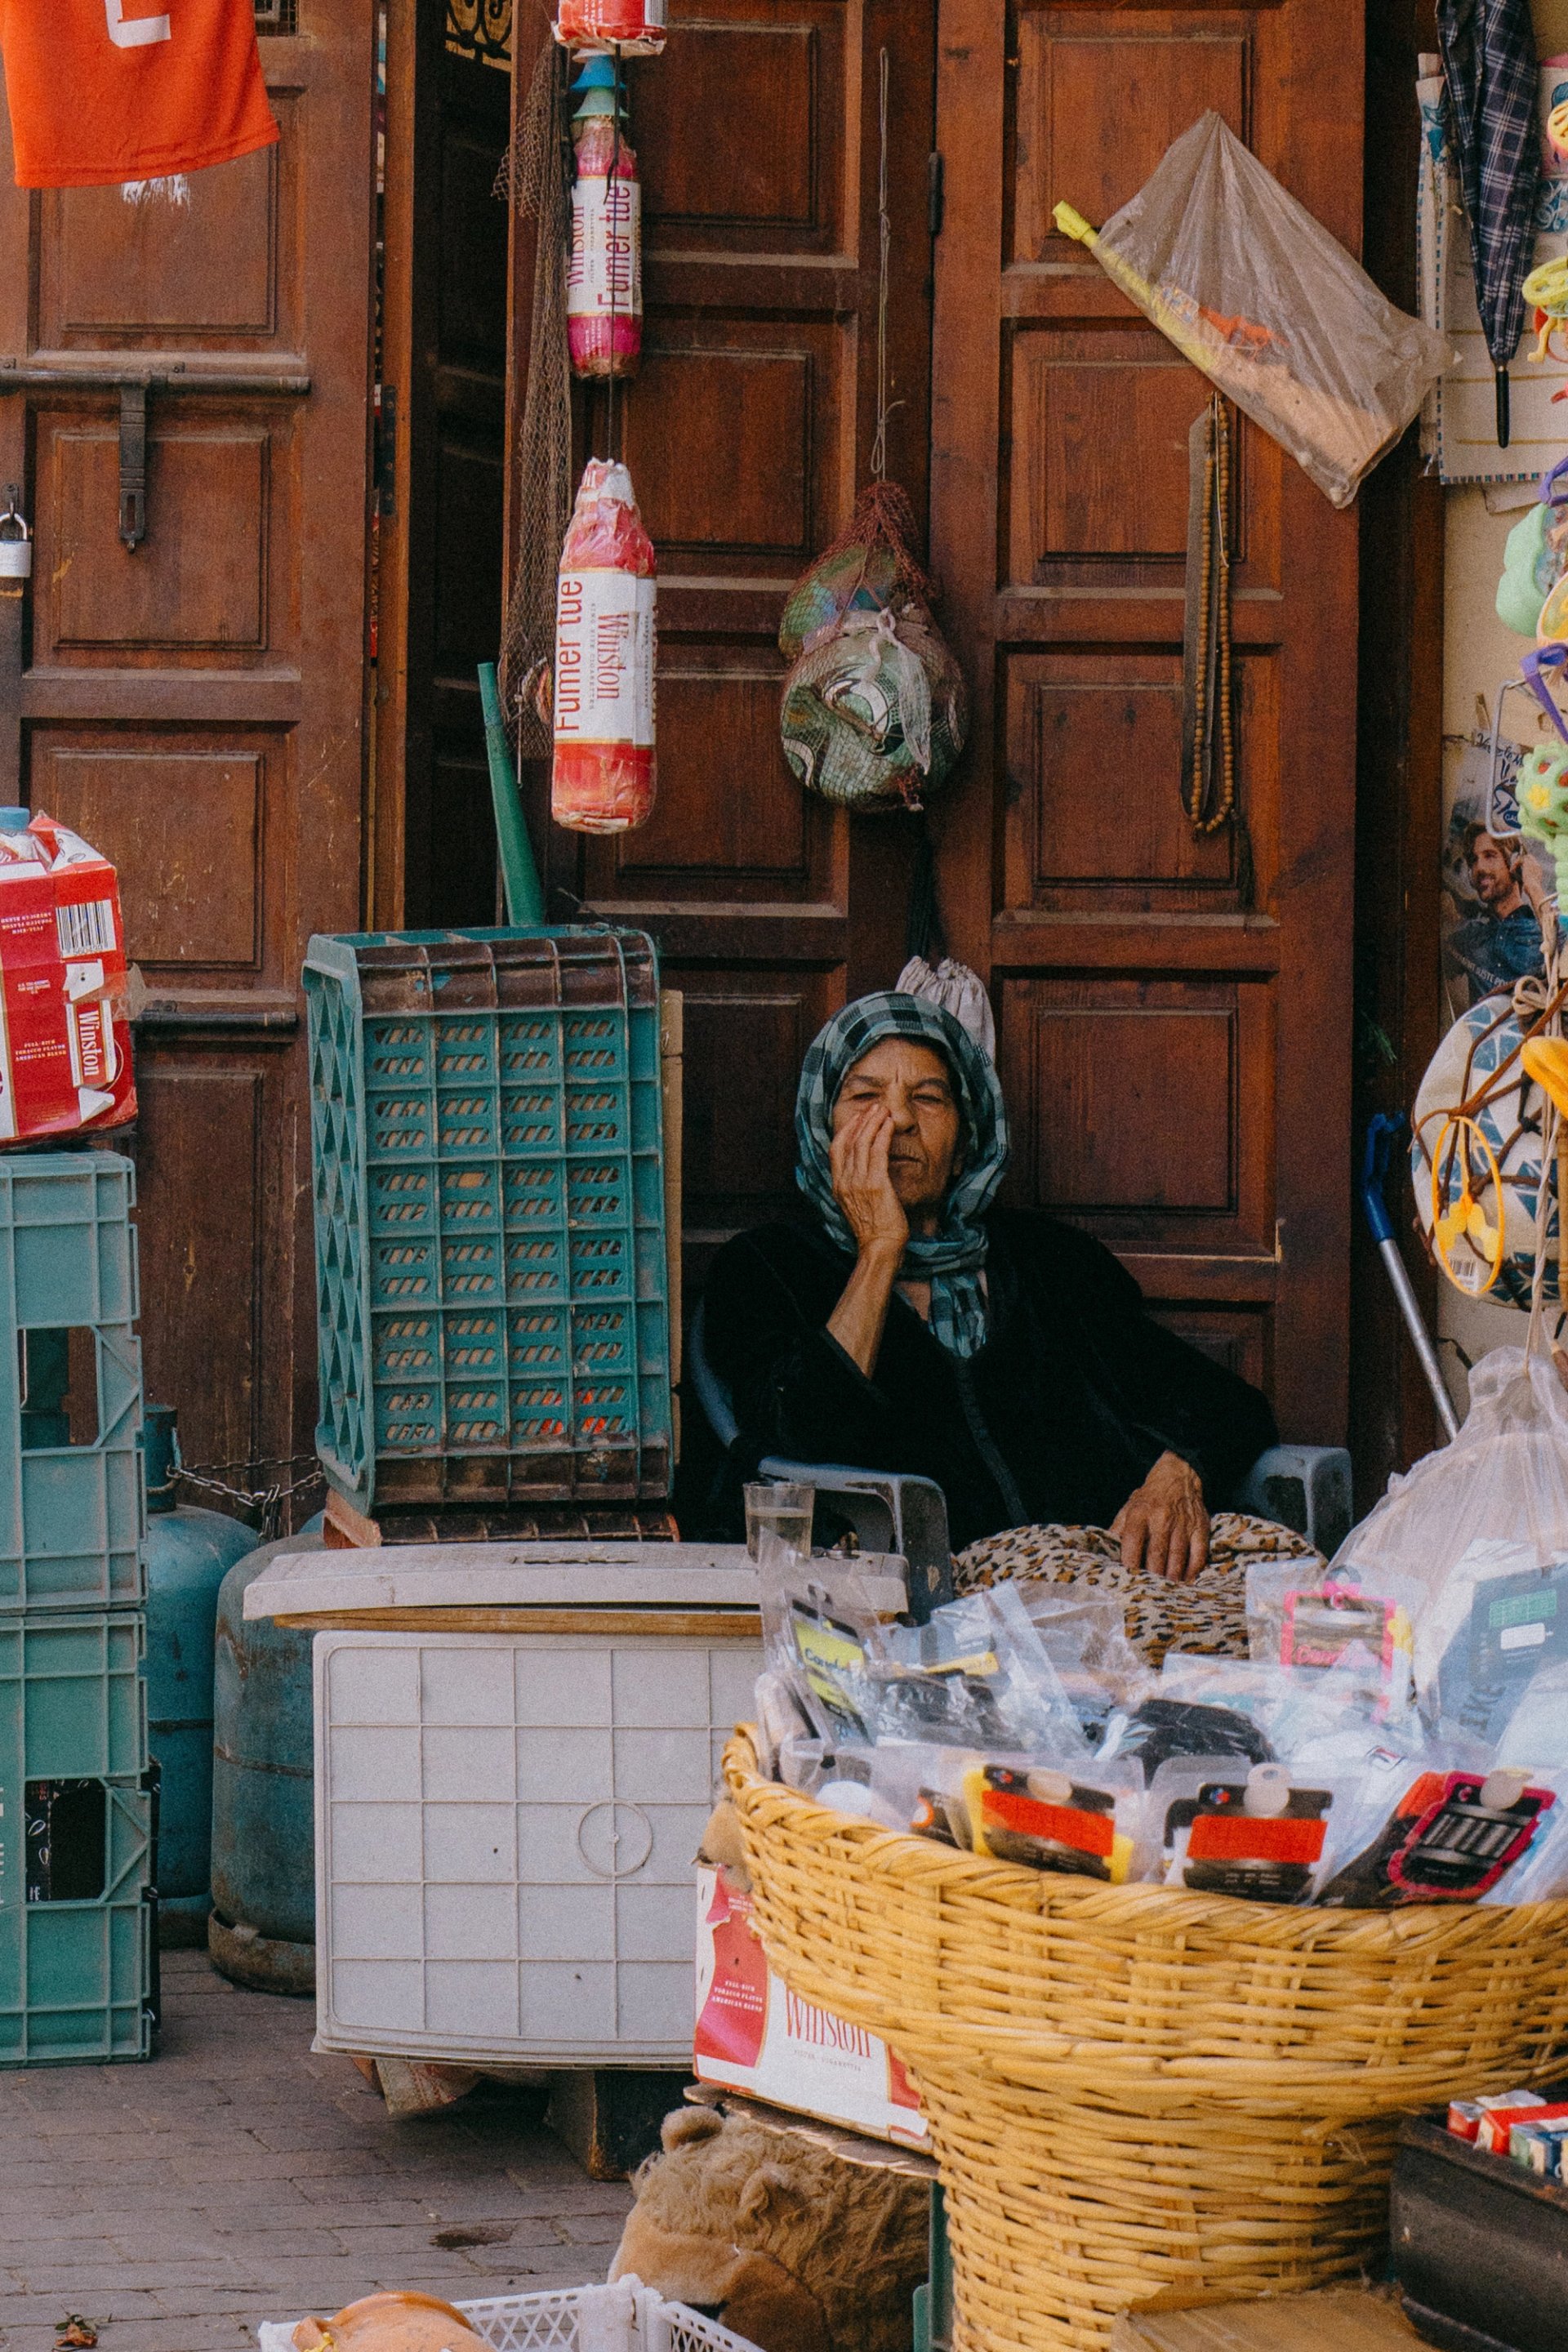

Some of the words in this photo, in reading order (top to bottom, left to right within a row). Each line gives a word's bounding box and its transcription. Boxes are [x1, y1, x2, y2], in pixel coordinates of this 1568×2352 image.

[599, 185, 631, 223] tue
[597, 229, 630, 307] Fumer
[557, 581, 583, 628] tue
[555, 637, 581, 731] Fumer
[597, 612, 630, 701] Winston
[78, 1009, 103, 1076] Winston
